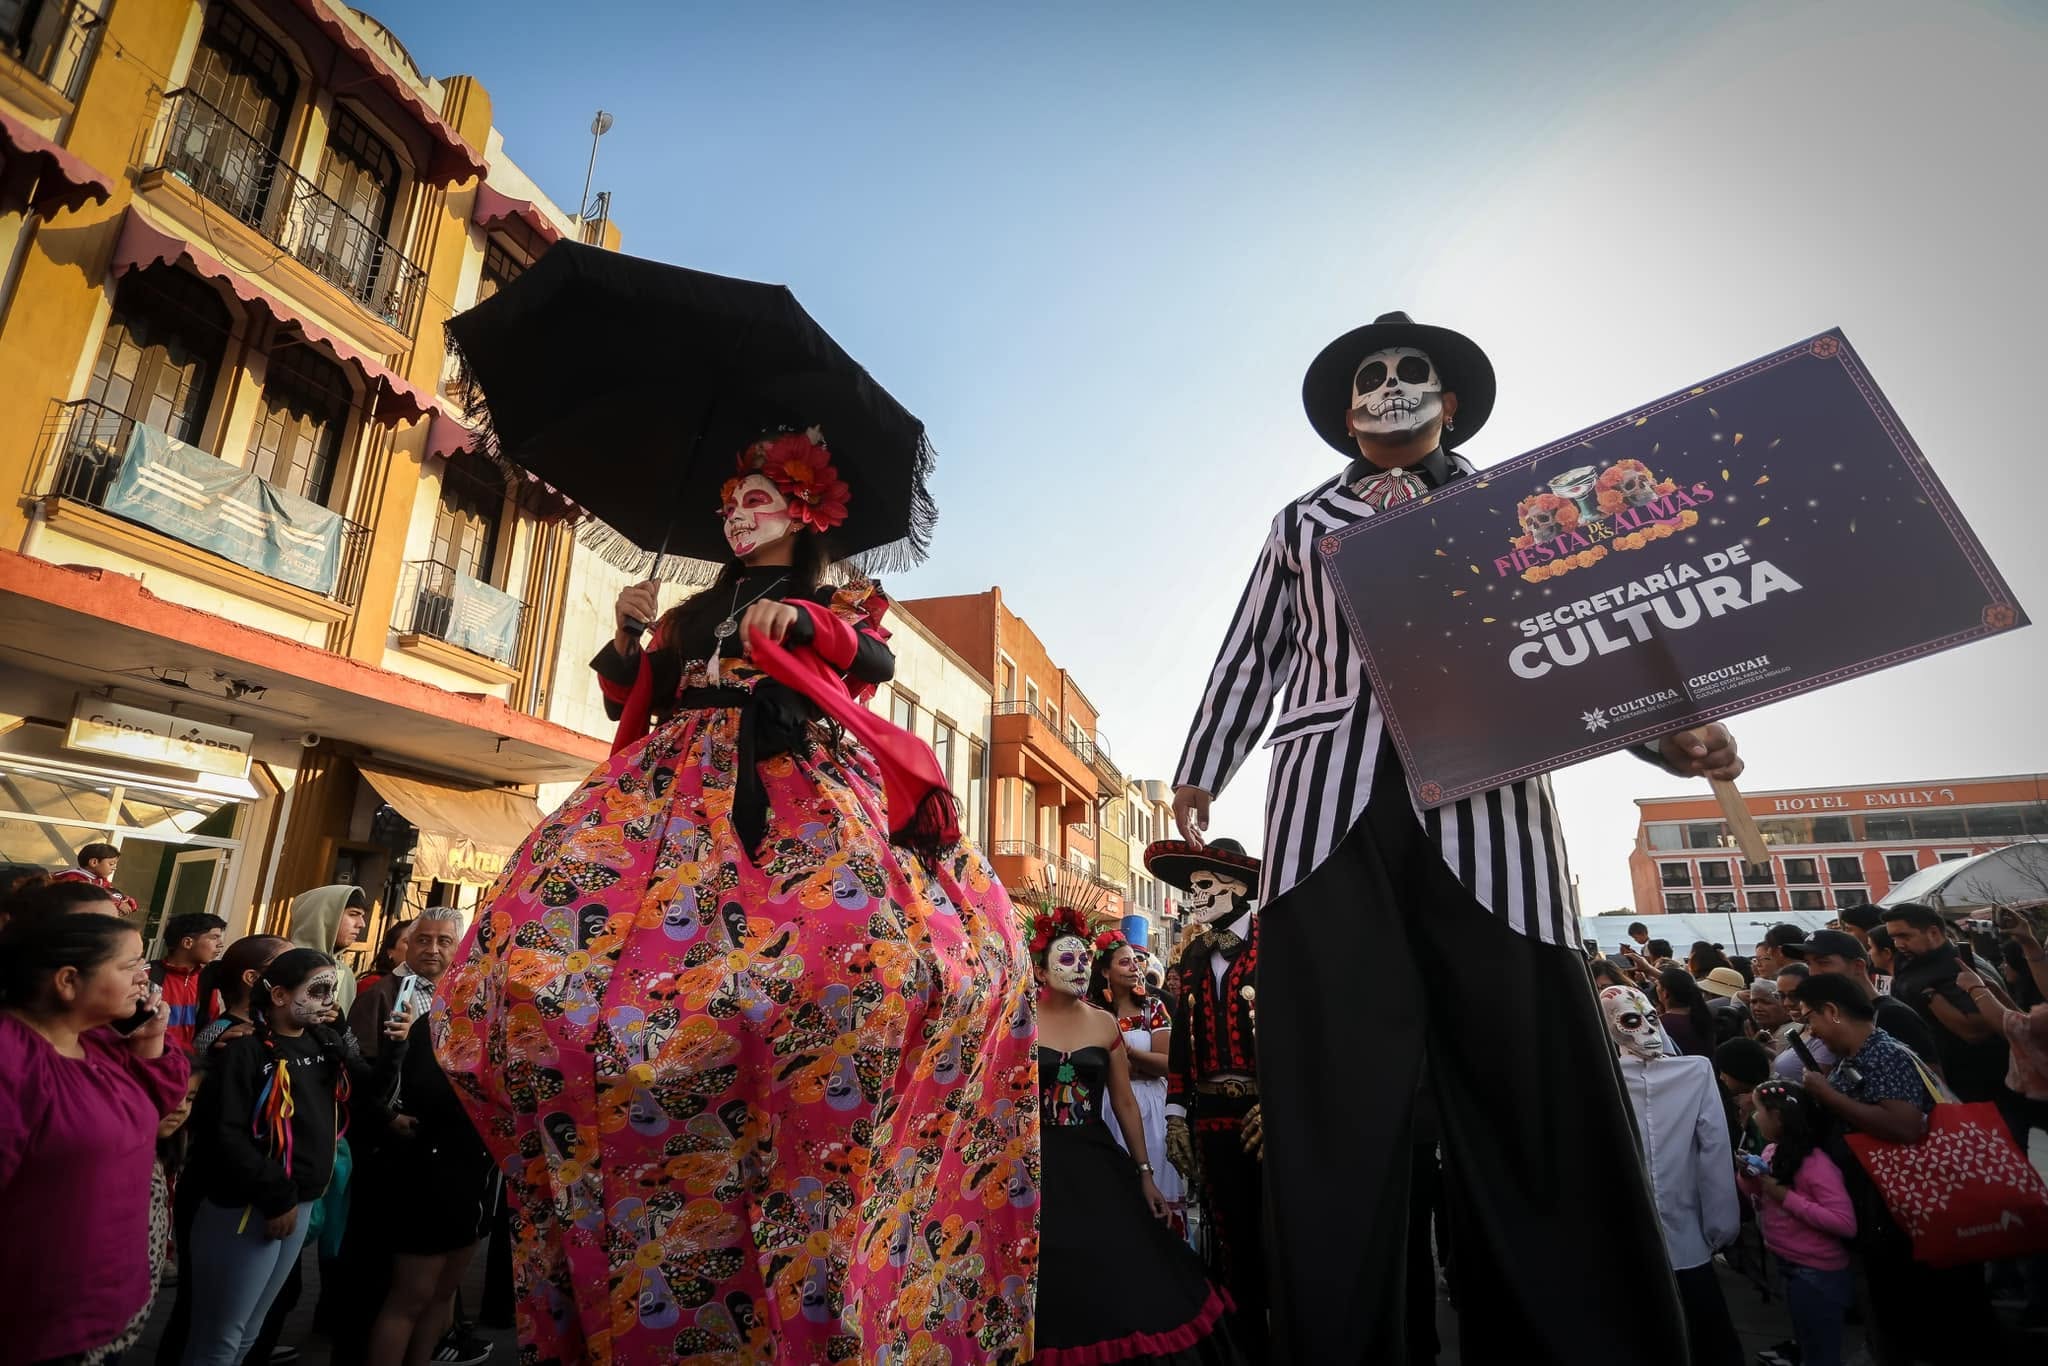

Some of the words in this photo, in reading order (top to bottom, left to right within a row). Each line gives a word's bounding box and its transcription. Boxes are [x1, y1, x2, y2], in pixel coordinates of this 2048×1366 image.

[1588, 521, 1605, 534] DE
[1589, 528, 1614, 543] LAS
[1493, 531, 1589, 577] FIESTA
[1519, 563, 1701, 637] SECRETARÍA
[1703, 544, 1750, 573] DE
[1508, 560, 1803, 679] CULTURA
[1688, 654, 1770, 689] CECULTAH
[1608, 687, 1678, 718] CULTURA
[1775, 797, 1849, 811] HOTEL
[1864, 791, 1936, 806] EMILY
